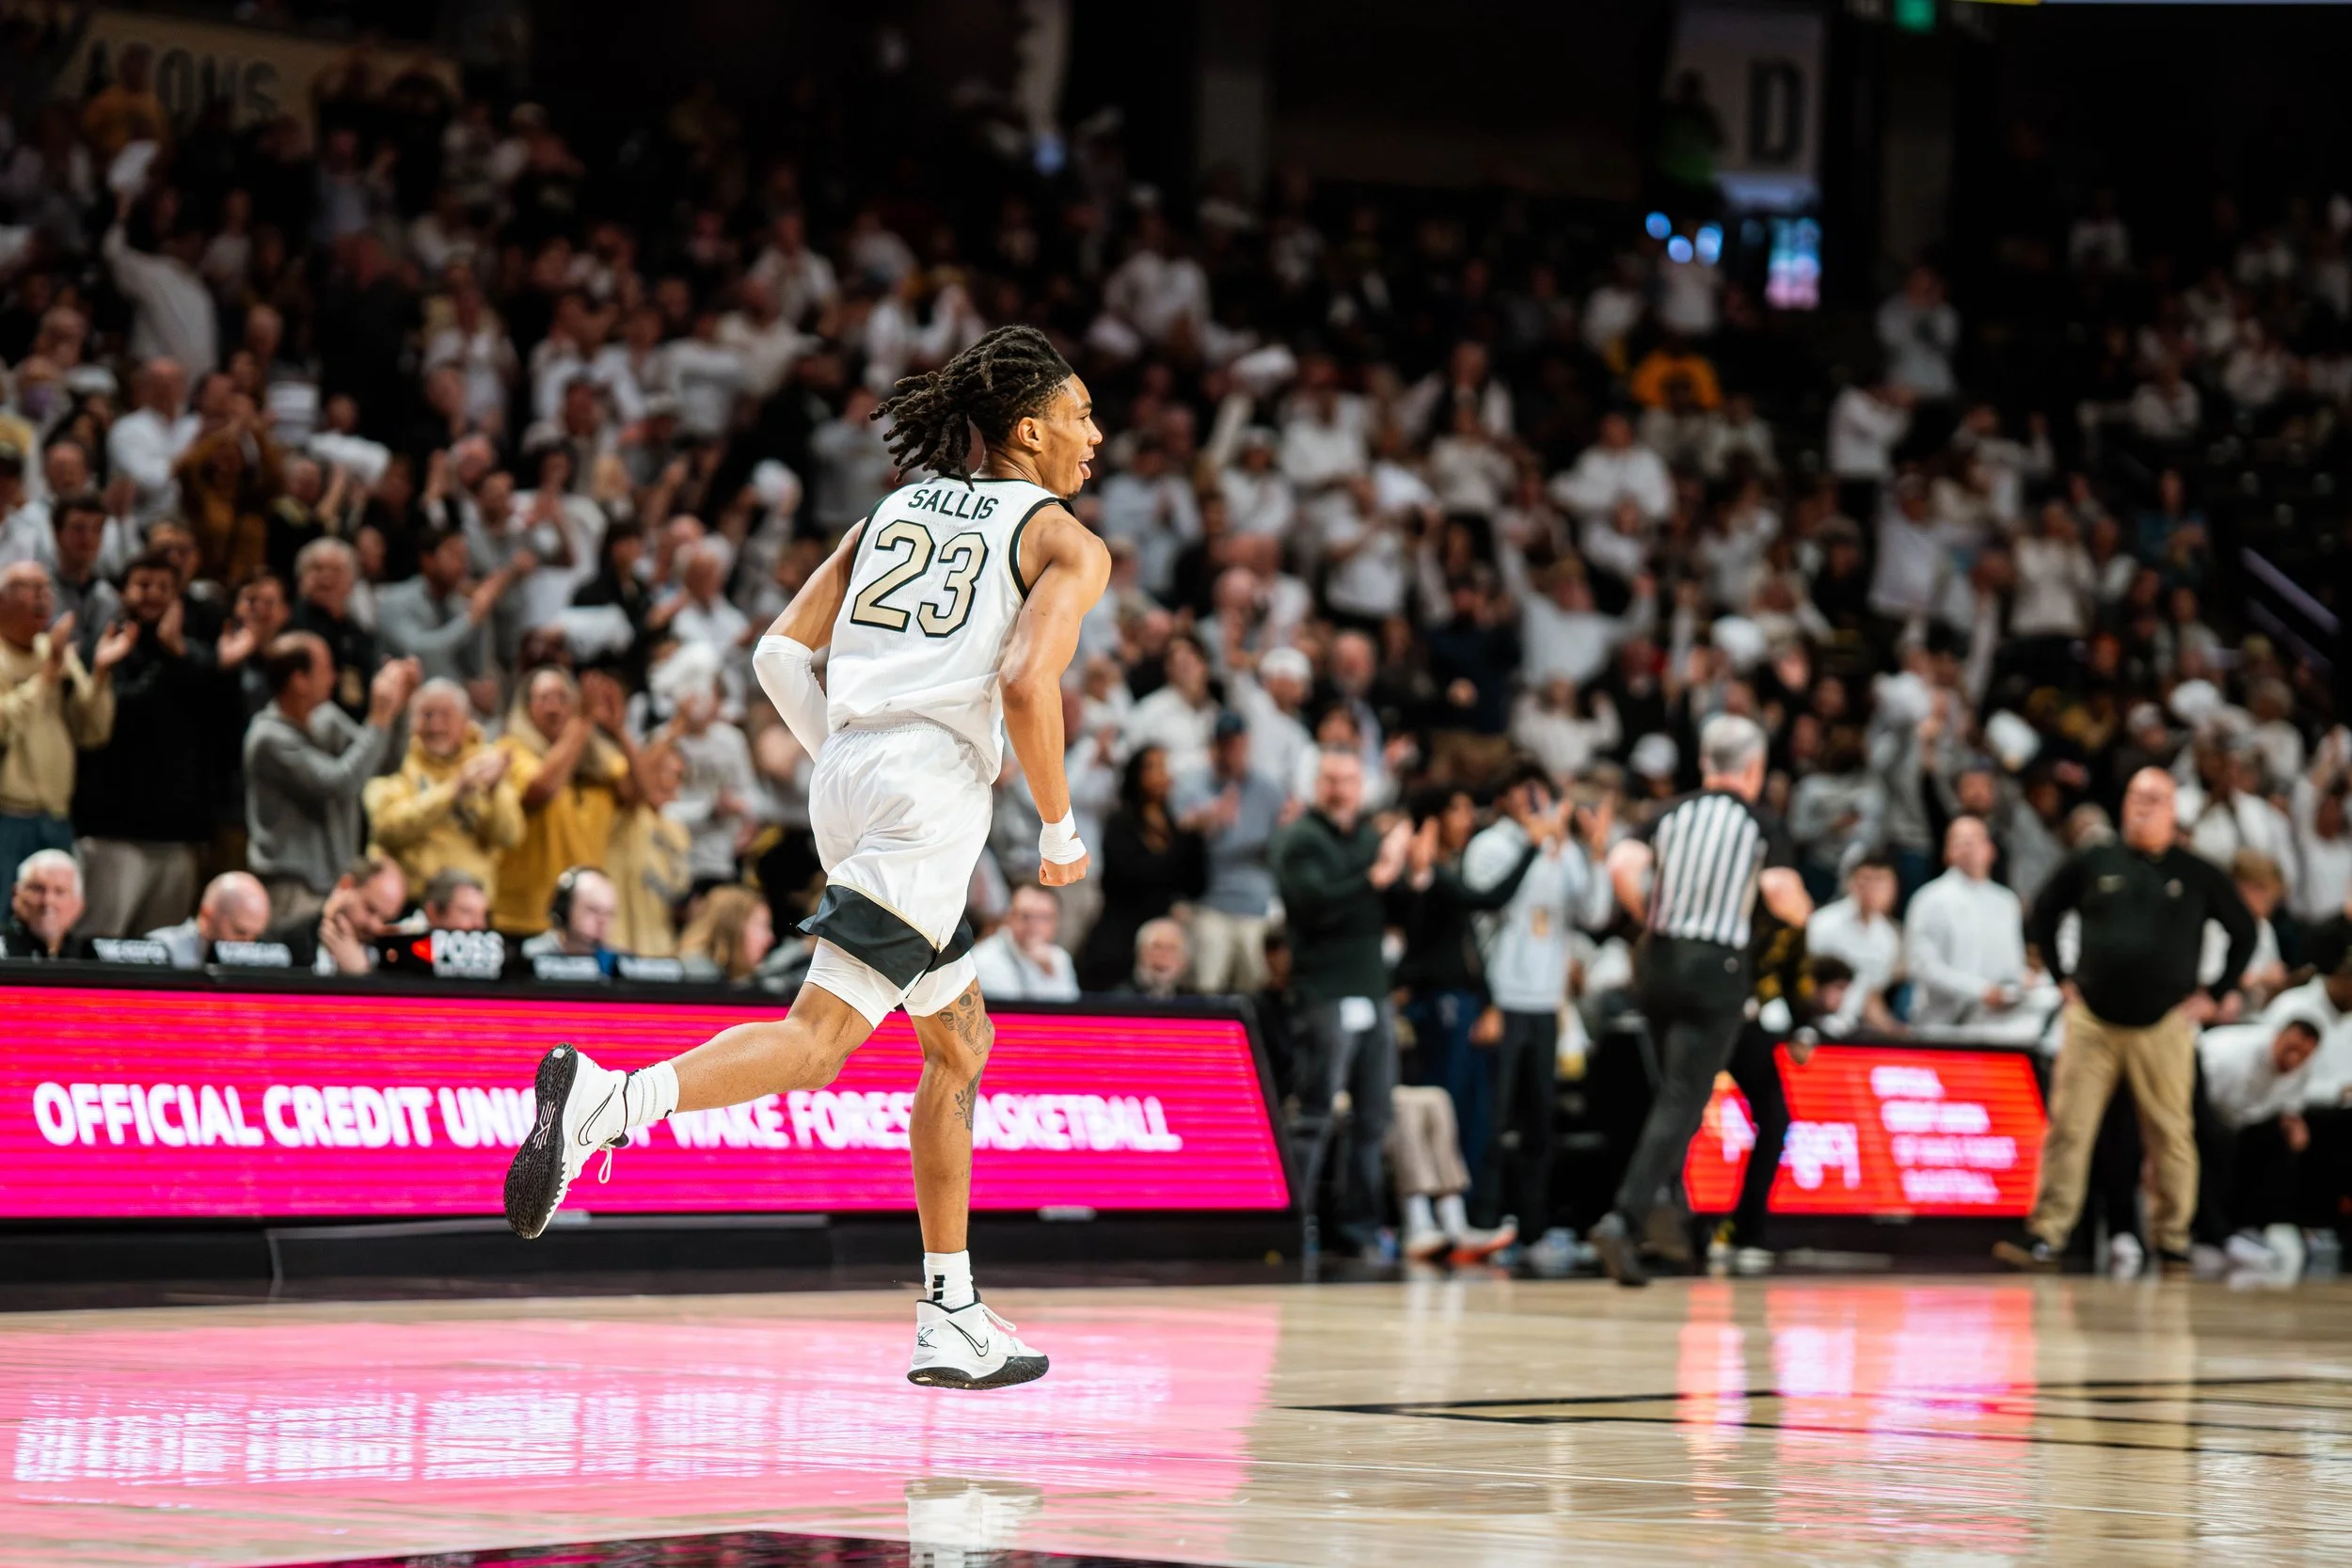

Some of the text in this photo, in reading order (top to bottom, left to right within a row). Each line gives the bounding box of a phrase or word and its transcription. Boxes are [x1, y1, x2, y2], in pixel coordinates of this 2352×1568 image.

[908, 489, 999, 520] SALLIS
[850, 519, 989, 638] 23
[33, 1082, 264, 1146] OFFICIAL
[262, 1085, 433, 1148] CREDIT
[787, 1090, 911, 1149] FORES
